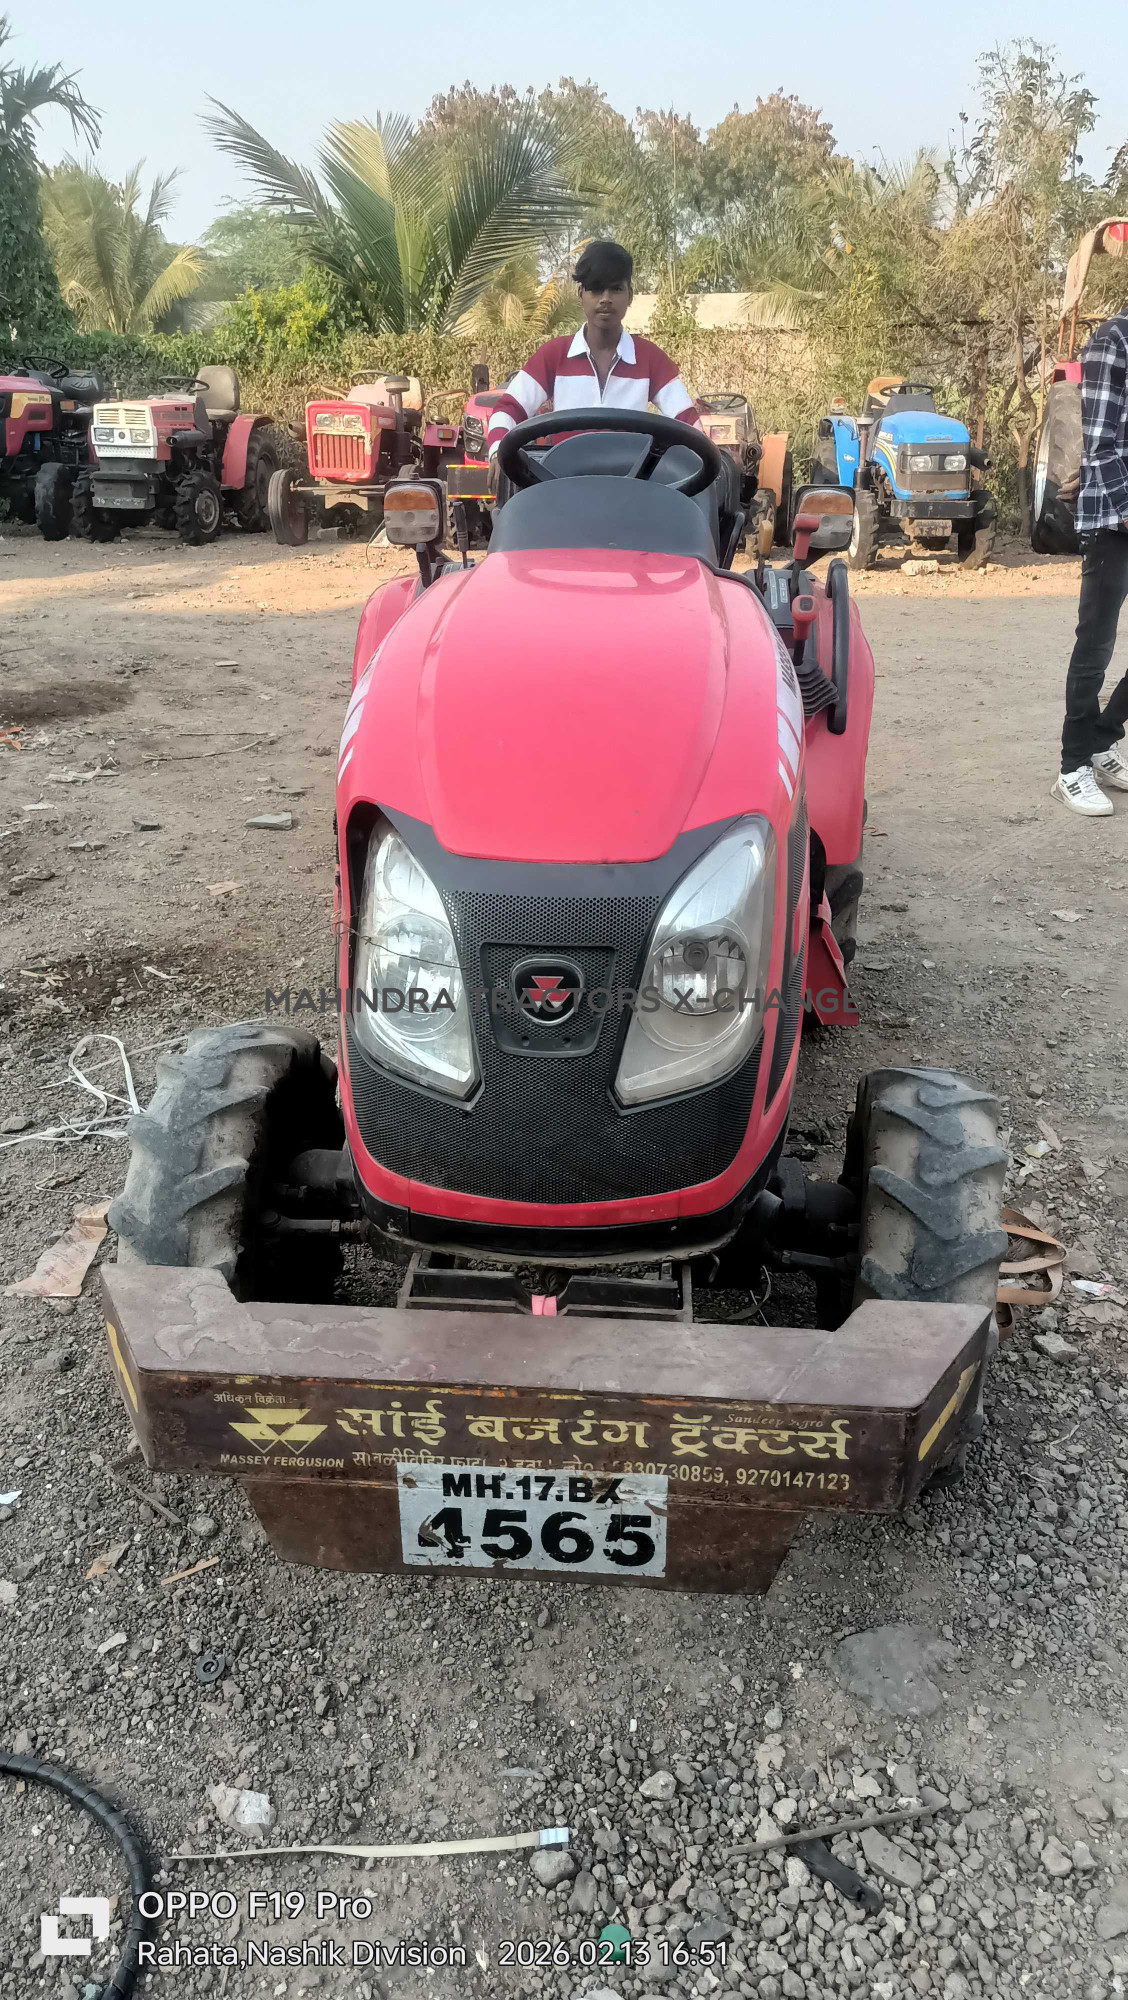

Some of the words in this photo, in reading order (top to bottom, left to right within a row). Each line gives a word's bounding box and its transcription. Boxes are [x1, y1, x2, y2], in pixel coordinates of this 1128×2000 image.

[465, 1409, 651, 1448] बजरंग
[724, 1413, 784, 1428] Sandeep
[220, 1454, 270, 1466] MASSEY
[274, 1456, 345, 1468] FERGUSION
[736, 1468, 850, 1491] 9270147123
[417, 1507, 656, 1567] 4565
